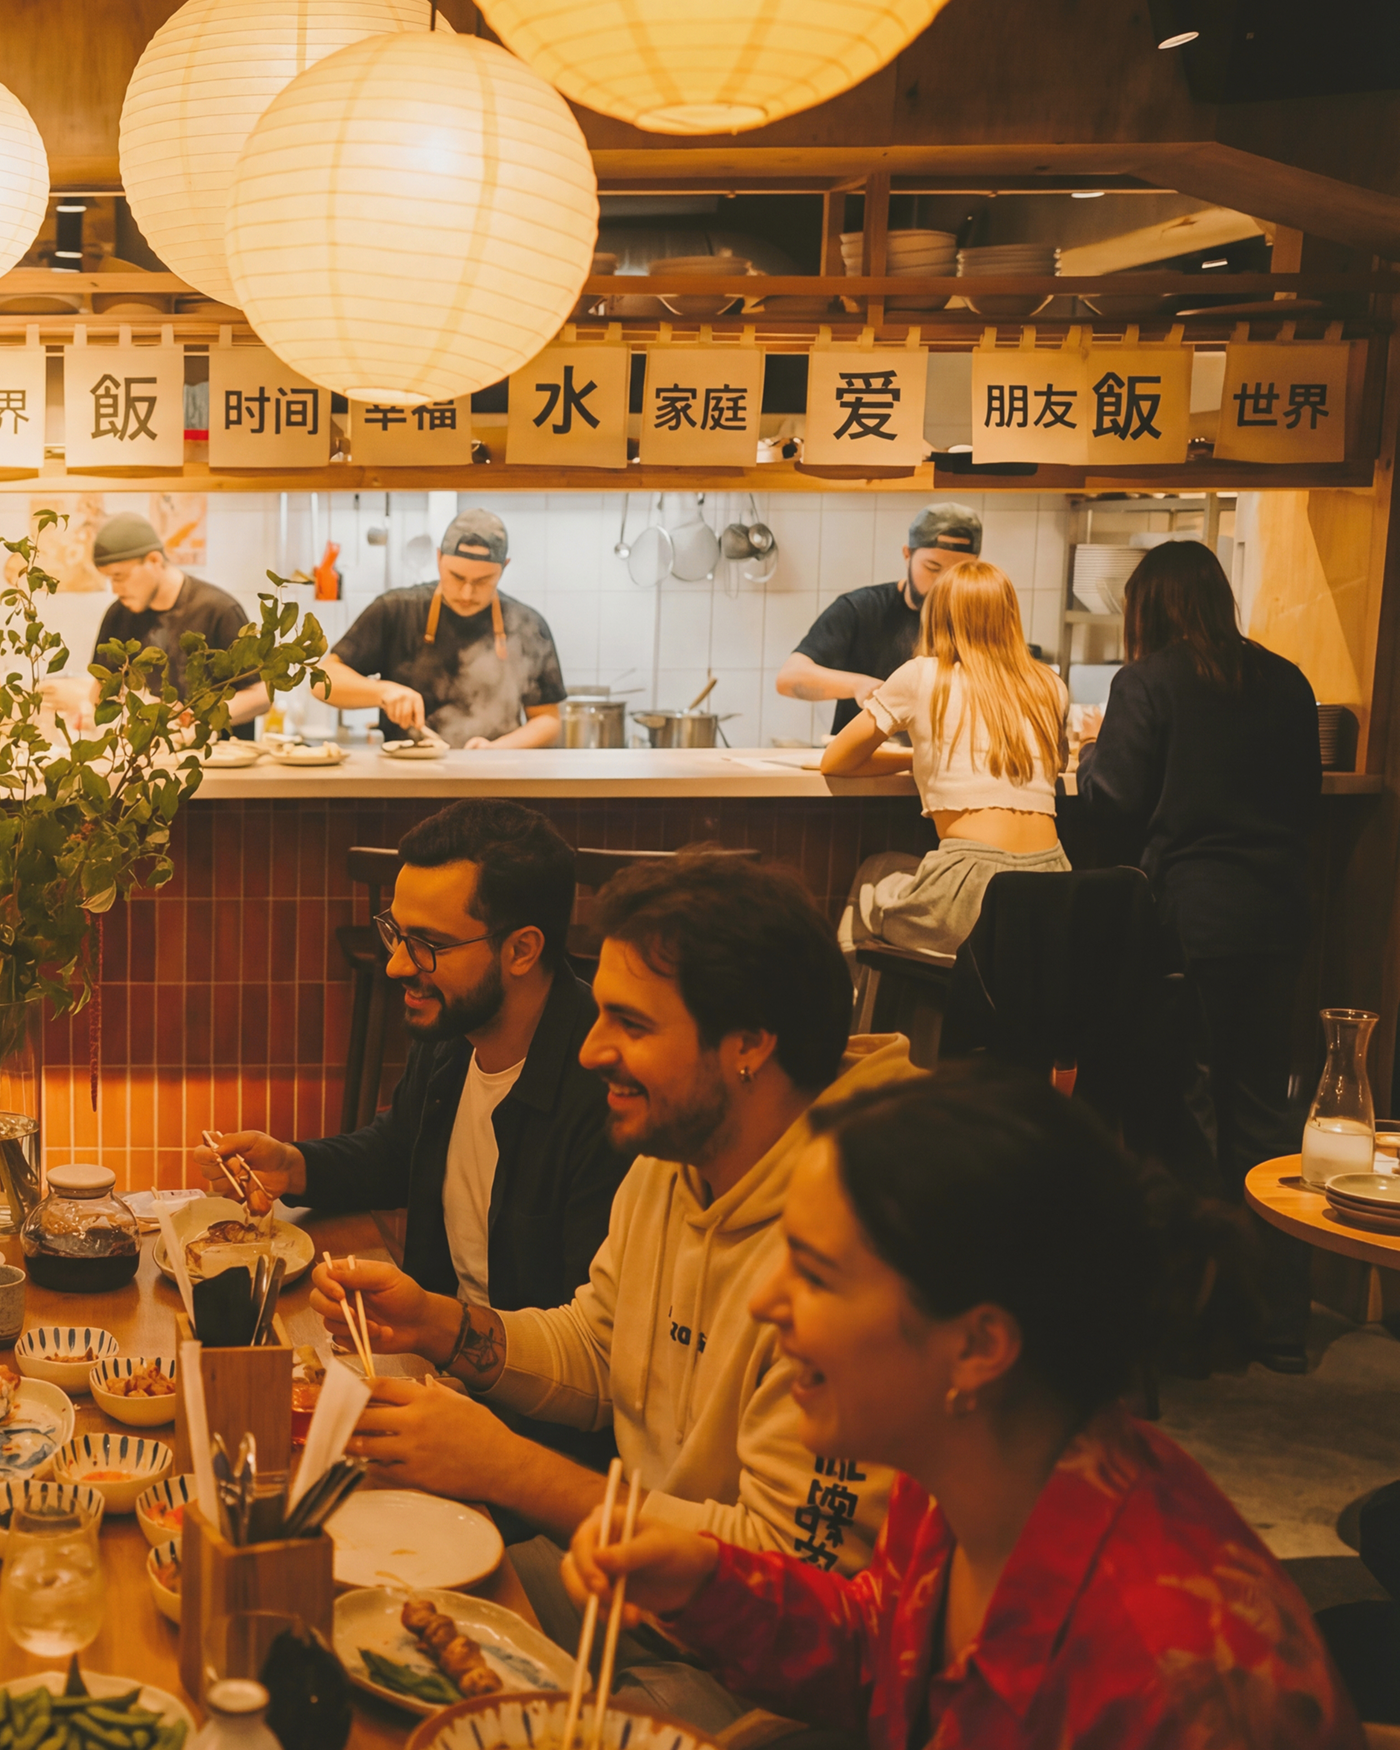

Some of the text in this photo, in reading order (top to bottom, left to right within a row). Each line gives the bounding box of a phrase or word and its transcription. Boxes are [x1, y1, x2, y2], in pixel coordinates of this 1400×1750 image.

[89, 373, 158, 441] 飯
[224, 387, 318, 435] 时间
[533, 366, 600, 434] 水
[653, 383, 748, 431] 家庭
[833, 370, 901, 440] 爱
[984, 383, 1078, 429] 朋友
[1092, 371, 1162, 440] 飯
[1233, 383, 1329, 429] 世界
